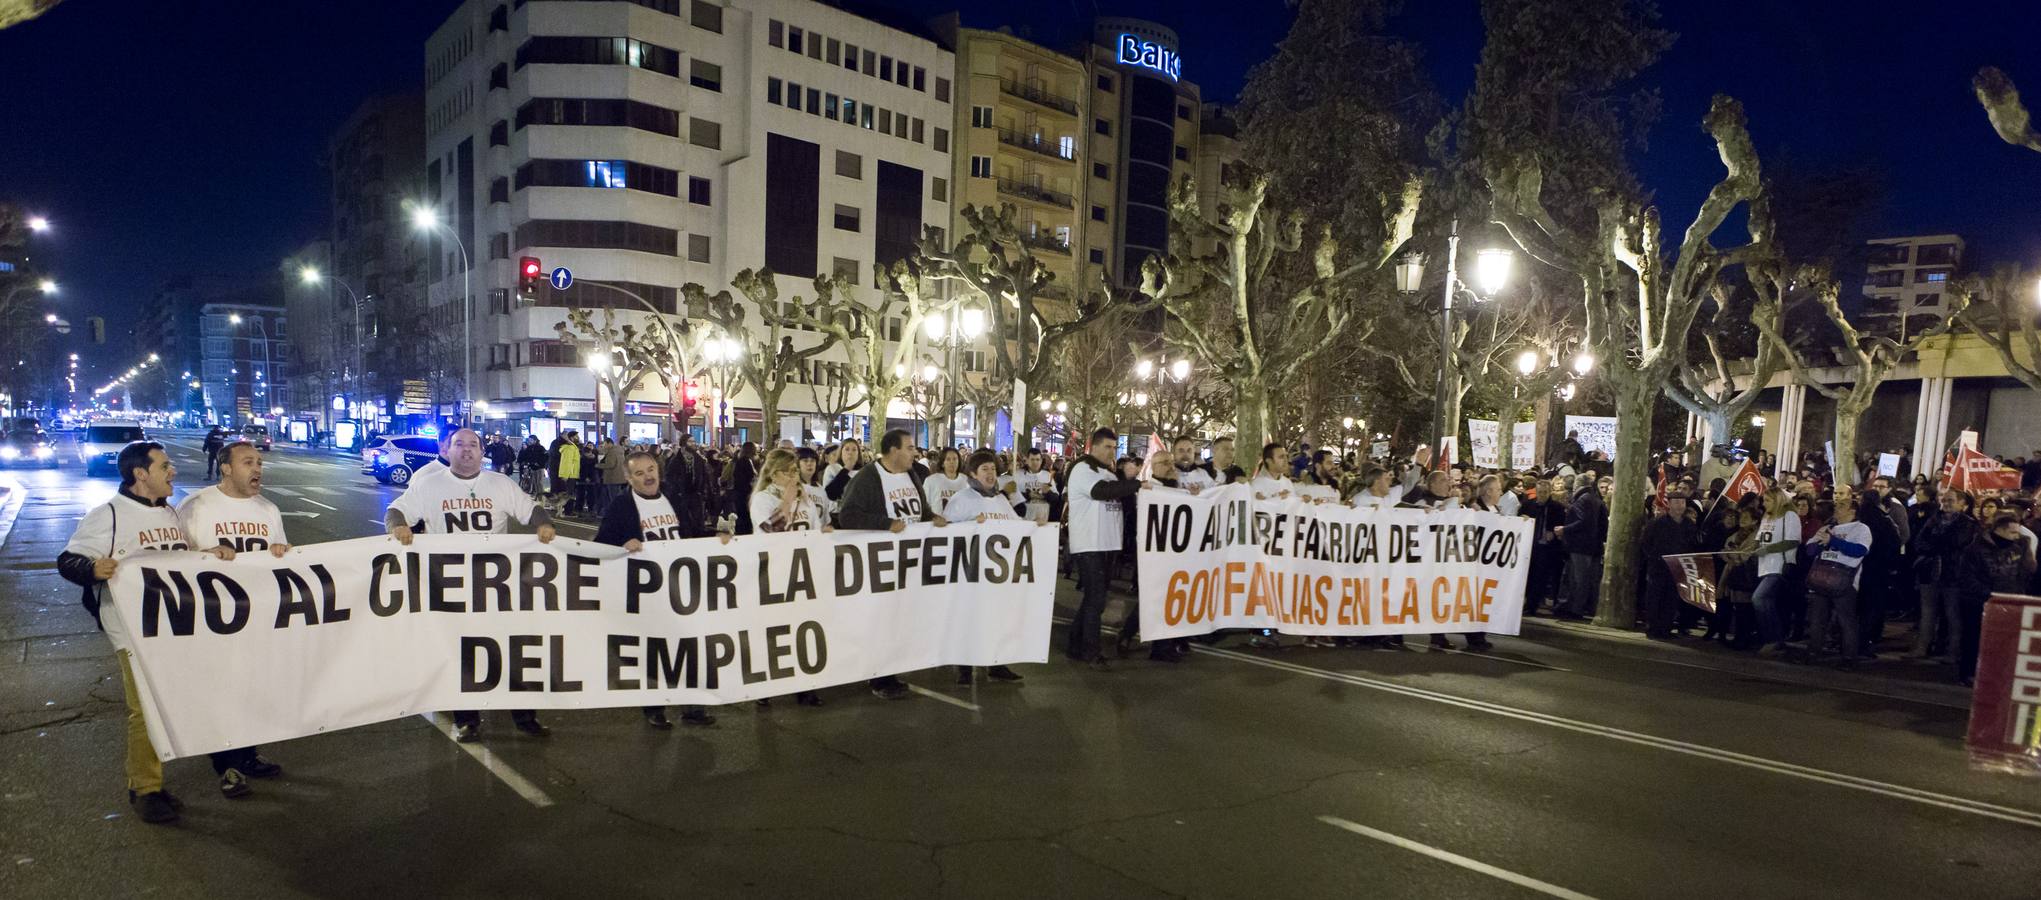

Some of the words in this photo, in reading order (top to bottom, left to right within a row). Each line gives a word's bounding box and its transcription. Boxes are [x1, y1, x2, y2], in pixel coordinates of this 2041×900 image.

[442, 498, 493, 511] ALTADIS
[893, 498, 921, 518] NO
[215, 521, 269, 537] ALTADIS
[444, 511, 492, 533] NO
[1145, 504, 1193, 553] NO
[1199, 503, 1222, 552] AL
[1389, 524, 1422, 563] DE
[139, 527, 185, 545] ALTADI
[141, 567, 250, 637] NO
[272, 564, 351, 629] AL
[369, 552, 600, 617] CIERRE
[626, 555, 738, 616] POR
[758, 548, 817, 606] LA
[834, 534, 1035, 597] DEFENSA
[1165, 566, 1221, 627] 600
[1338, 577, 1371, 625] EN
[1382, 576, 1420, 625] LA
[461, 635, 583, 693] DEL
[607, 620, 828, 691] EMPLEO
